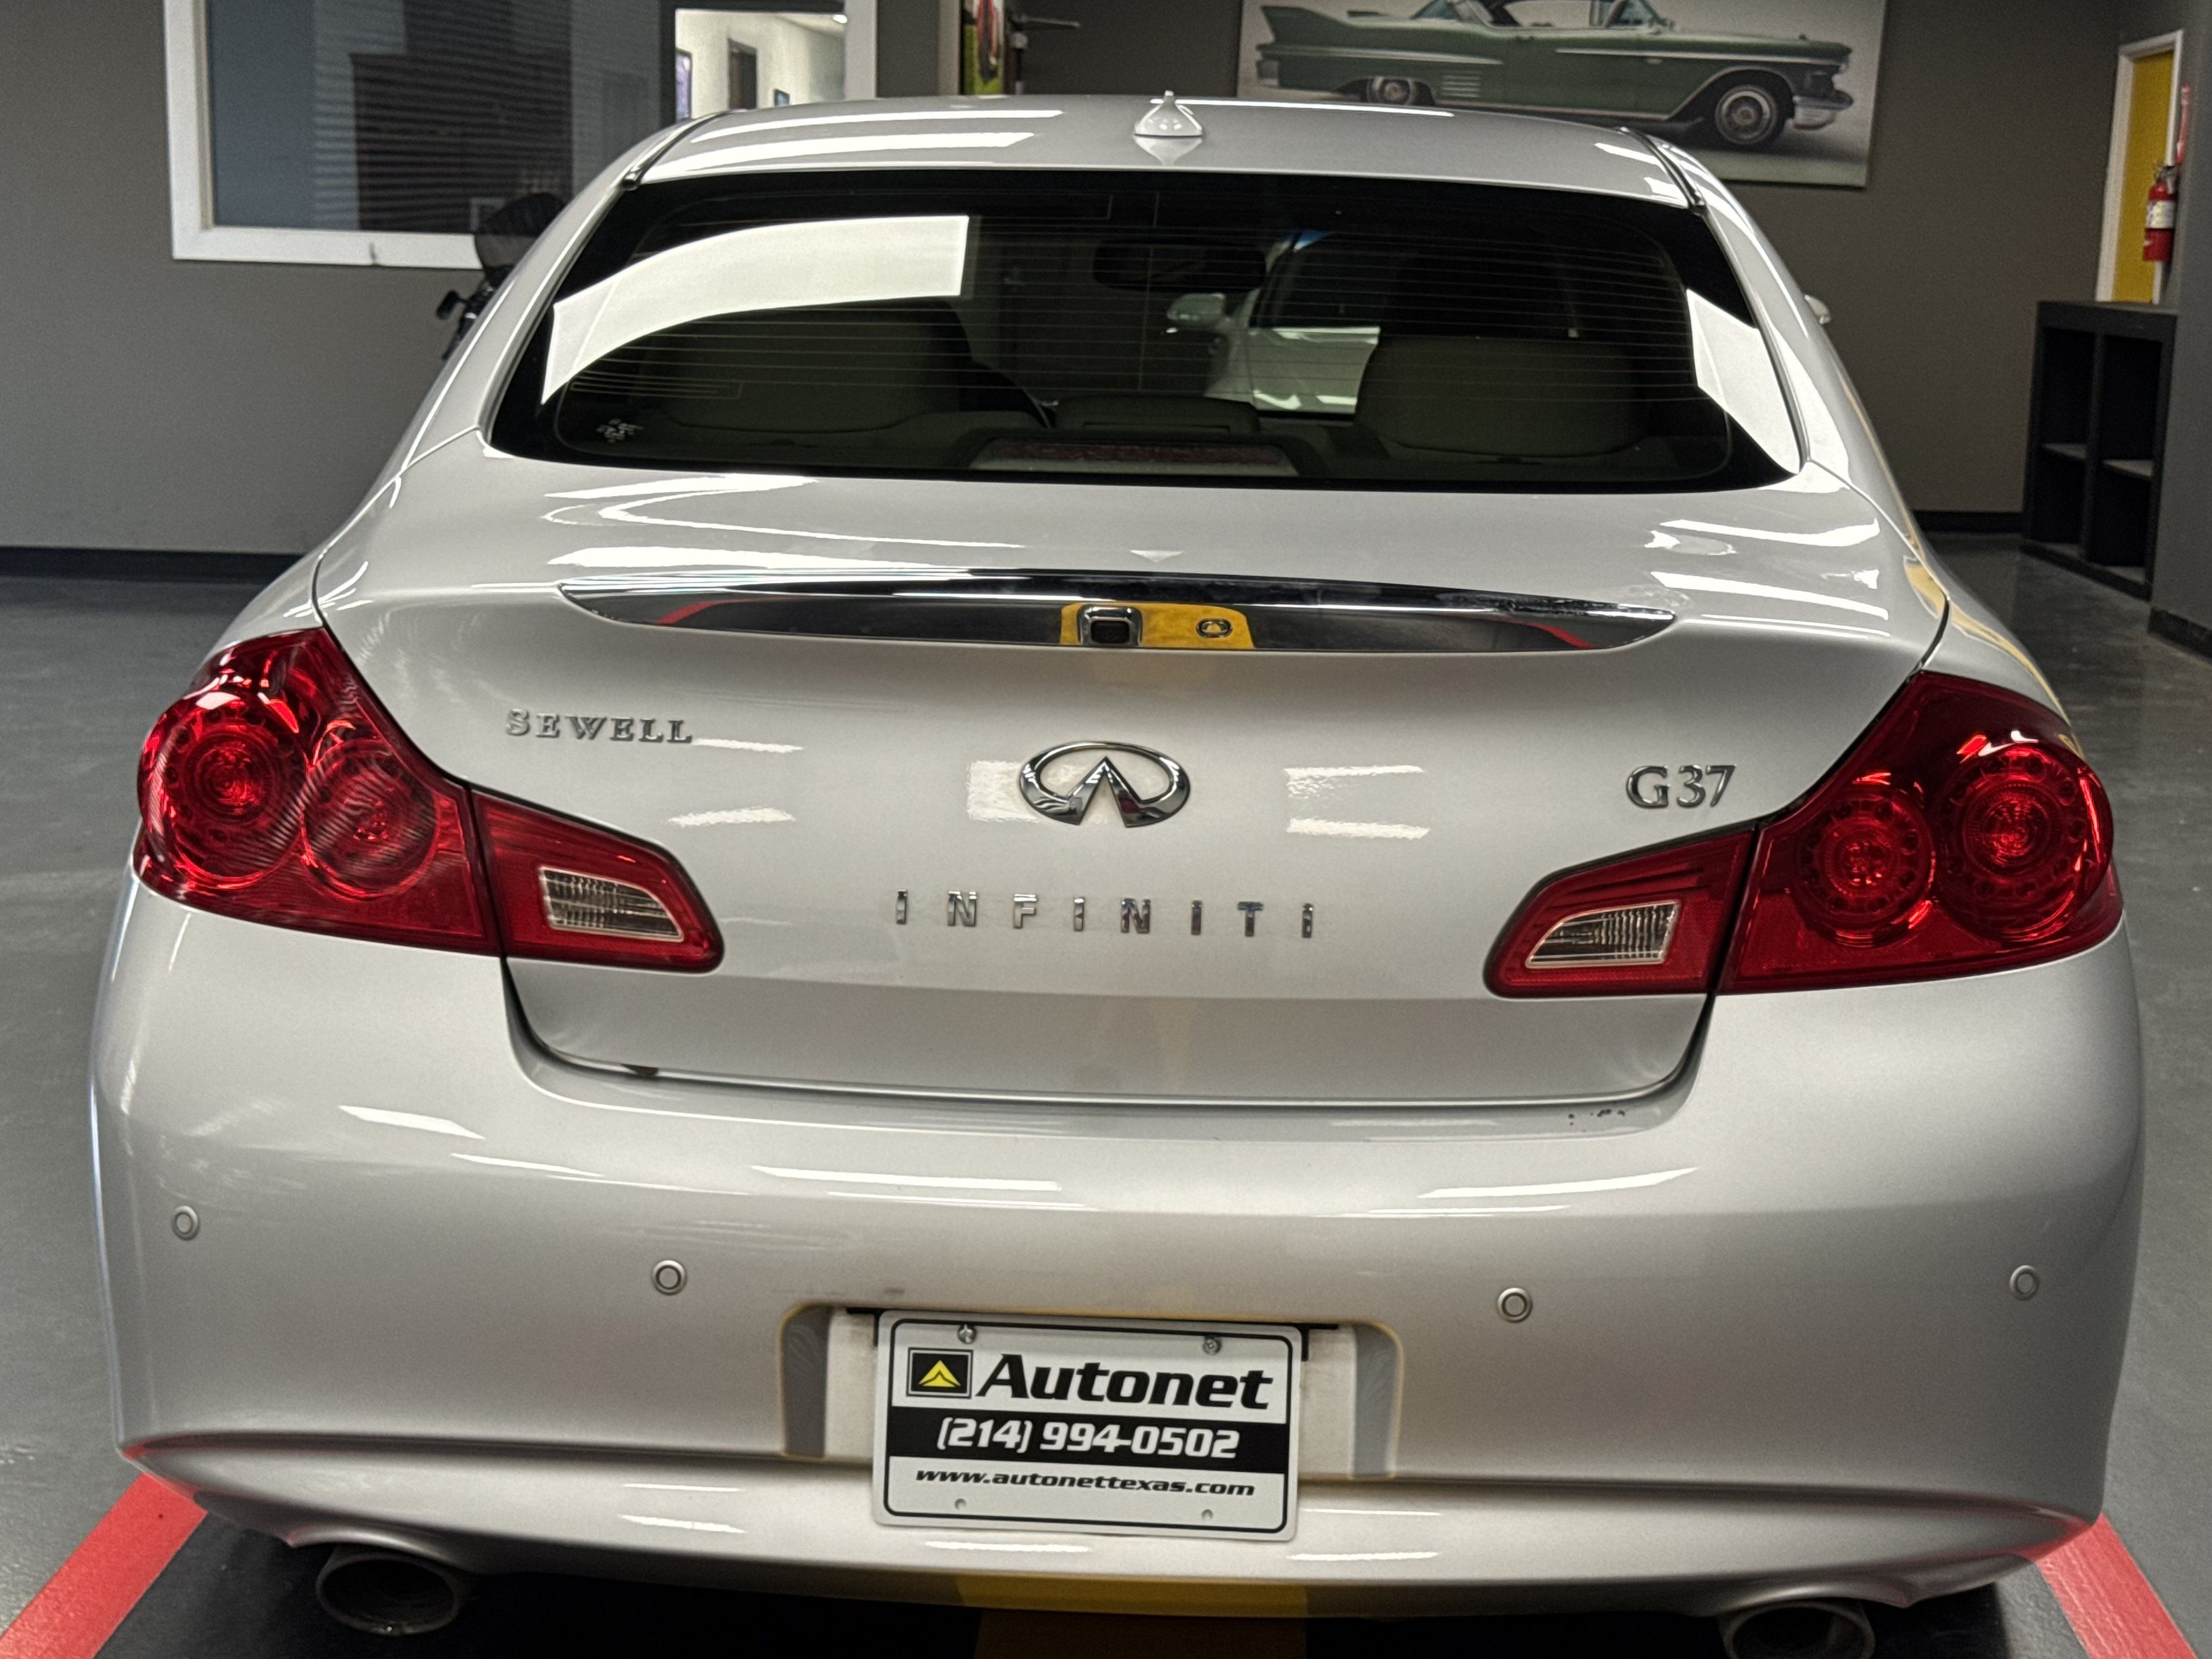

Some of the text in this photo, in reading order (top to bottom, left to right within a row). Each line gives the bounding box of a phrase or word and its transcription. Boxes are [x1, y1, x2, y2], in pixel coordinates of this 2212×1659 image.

[506, 708, 693, 743] SEWELL
[1625, 764, 1737, 809] G37
[895, 889, 1314, 939] INFINITI
[975, 1353, 1274, 1410] Autonet
[937, 1417, 1240, 1459] (214) 994-0502
[915, 1469, 1255, 1496] www.autonettexas.com
